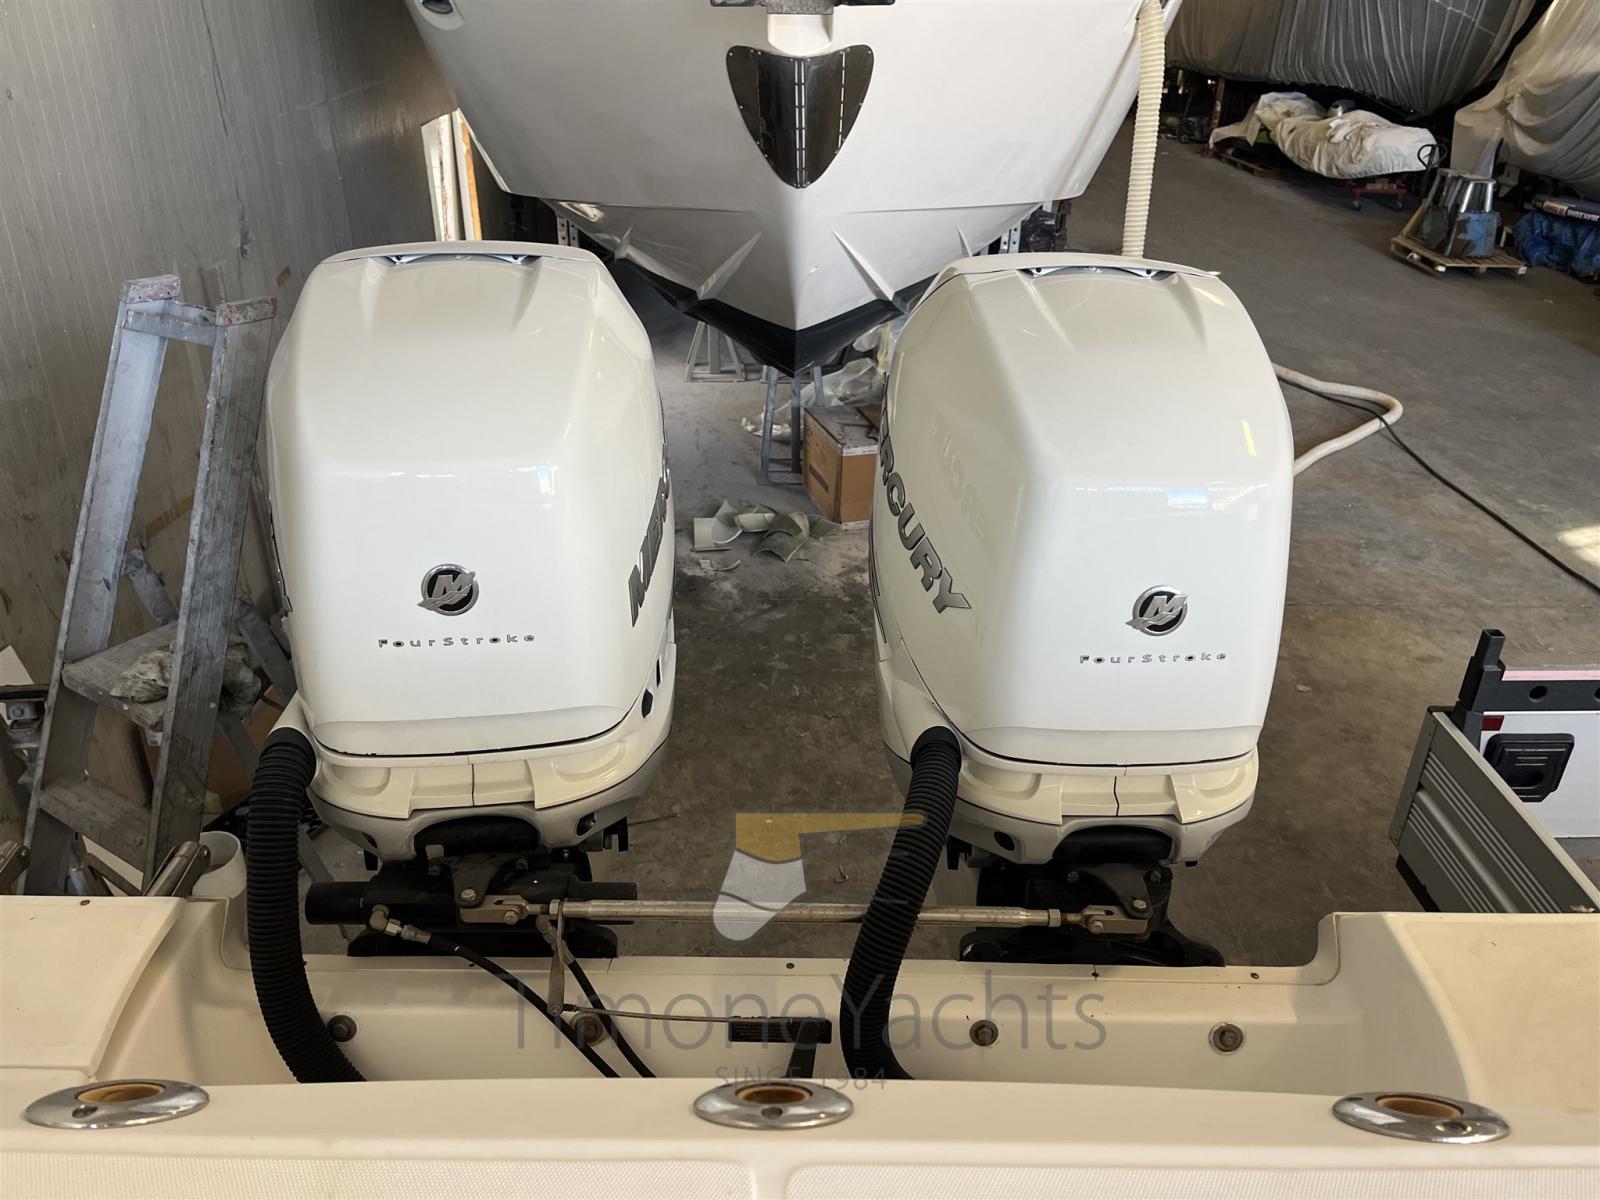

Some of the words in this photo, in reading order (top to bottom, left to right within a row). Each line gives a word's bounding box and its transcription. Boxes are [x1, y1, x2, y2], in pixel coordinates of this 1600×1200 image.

[879, 371, 972, 614] RCURY
[378, 634, 535, 648] FourStroke
[1079, 652, 1227, 665] FourStroke
